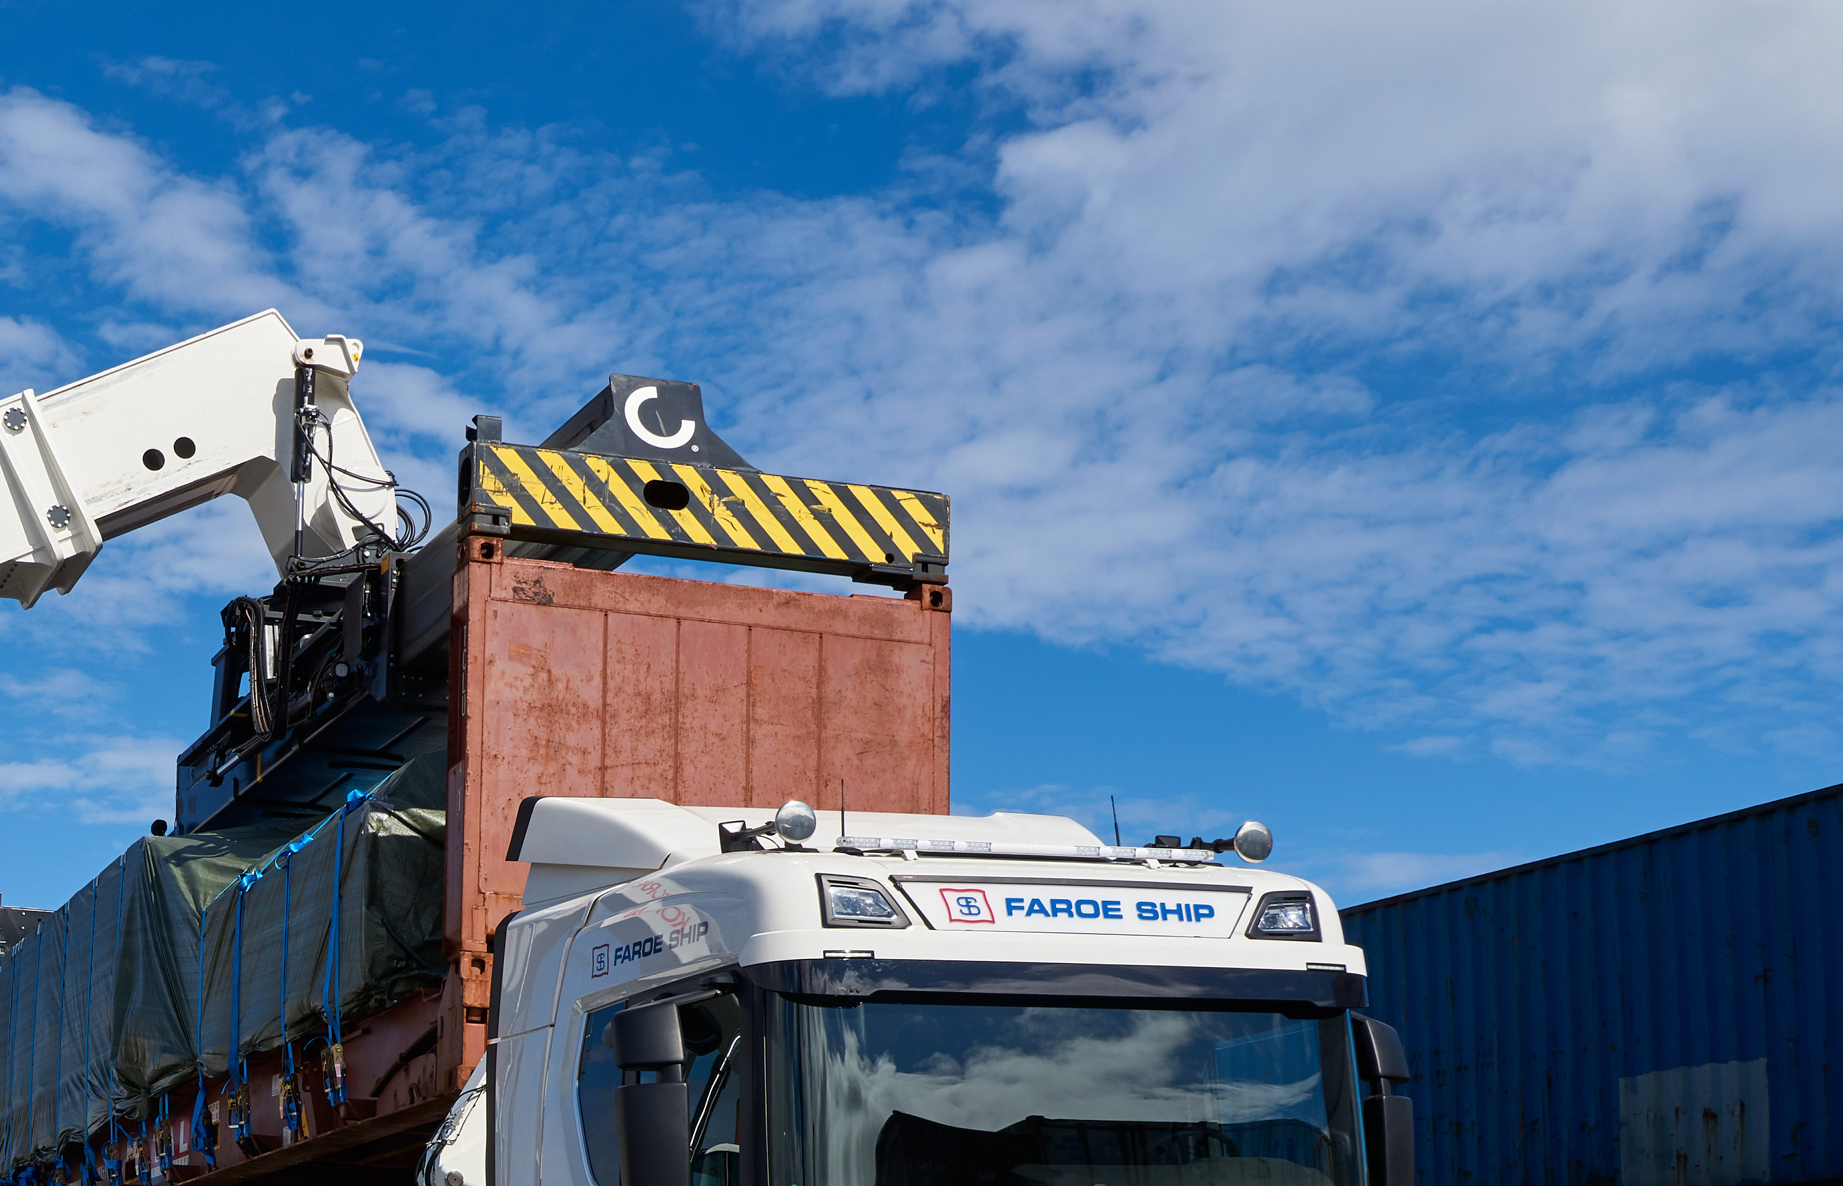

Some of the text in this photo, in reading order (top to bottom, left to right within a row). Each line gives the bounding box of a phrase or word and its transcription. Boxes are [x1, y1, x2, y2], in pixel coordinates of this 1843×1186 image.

[1004, 897, 1215, 923] FAROE SHIP
[613, 921, 709, 967] FAROE SHIP
